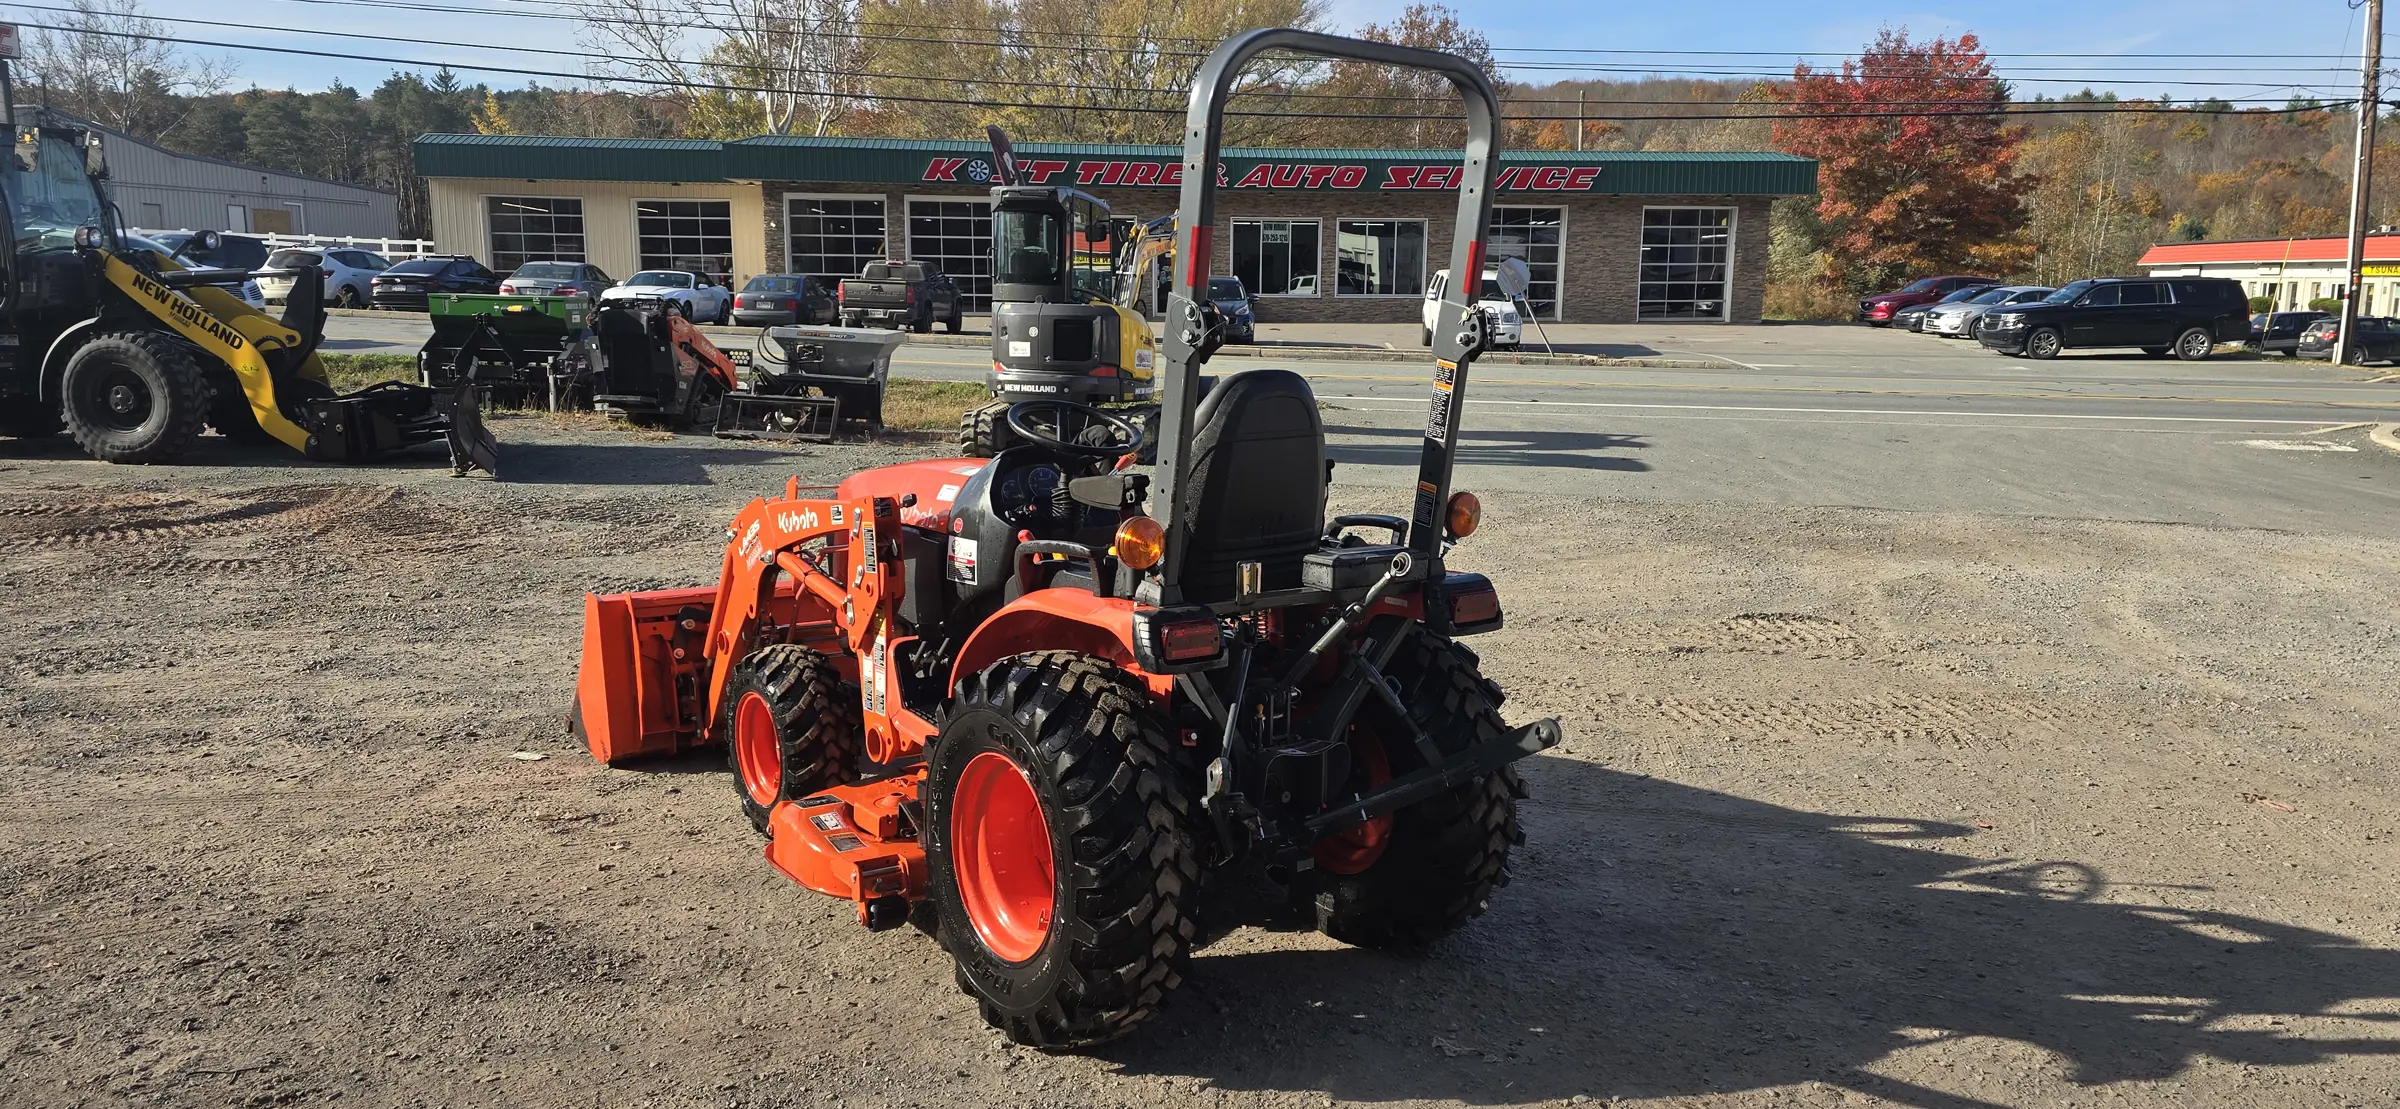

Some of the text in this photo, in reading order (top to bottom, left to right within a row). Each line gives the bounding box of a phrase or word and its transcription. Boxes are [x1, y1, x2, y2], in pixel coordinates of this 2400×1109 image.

[1076, 160, 1184, 186] TIRE
[1235, 164, 1367, 189] AUTO
[2370, 266, 2400, 274] TSUNA
[132, 274, 170, 305] NEW
[170, 299, 243, 350] HOLLAND
[1004, 384, 1057, 393] NEW HOLLAND
[778, 507, 818, 533] Kubota
